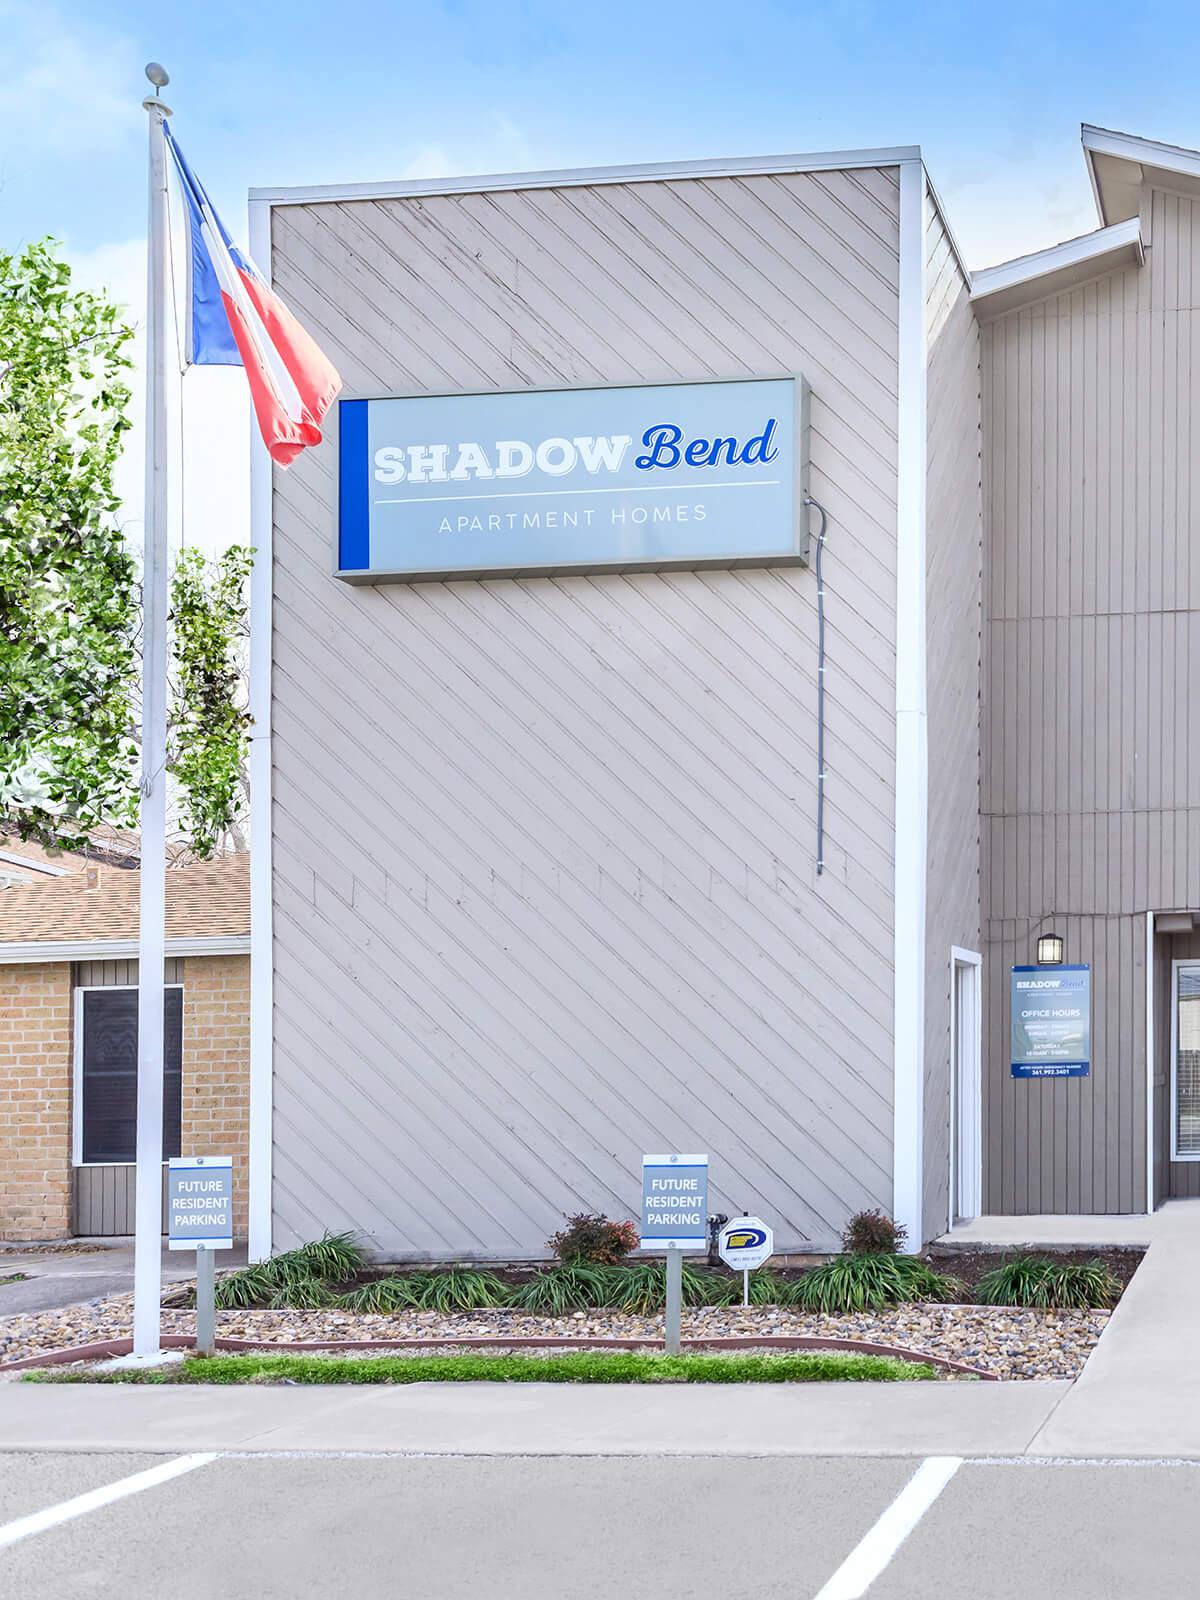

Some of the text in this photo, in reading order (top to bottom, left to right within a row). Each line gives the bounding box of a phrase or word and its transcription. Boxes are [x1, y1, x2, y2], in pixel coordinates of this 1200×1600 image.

[374, 417, 780, 485] SHADOW Bend
[438, 504, 708, 534] APARTMENT HOMES
[1016, 981, 1061, 989] SHADOW
[1021, 1008, 1081, 1018] OFFICE HOURS
[178, 1180, 223, 1192] FUTURE
[652, 1178, 698, 1191] FUTURE
[172, 1197, 229, 1209] RESIDENT
[645, 1196, 704, 1208] RESIDENT
[175, 1214, 226, 1226] PARKING
[647, 1213, 700, 1225] PARKING
